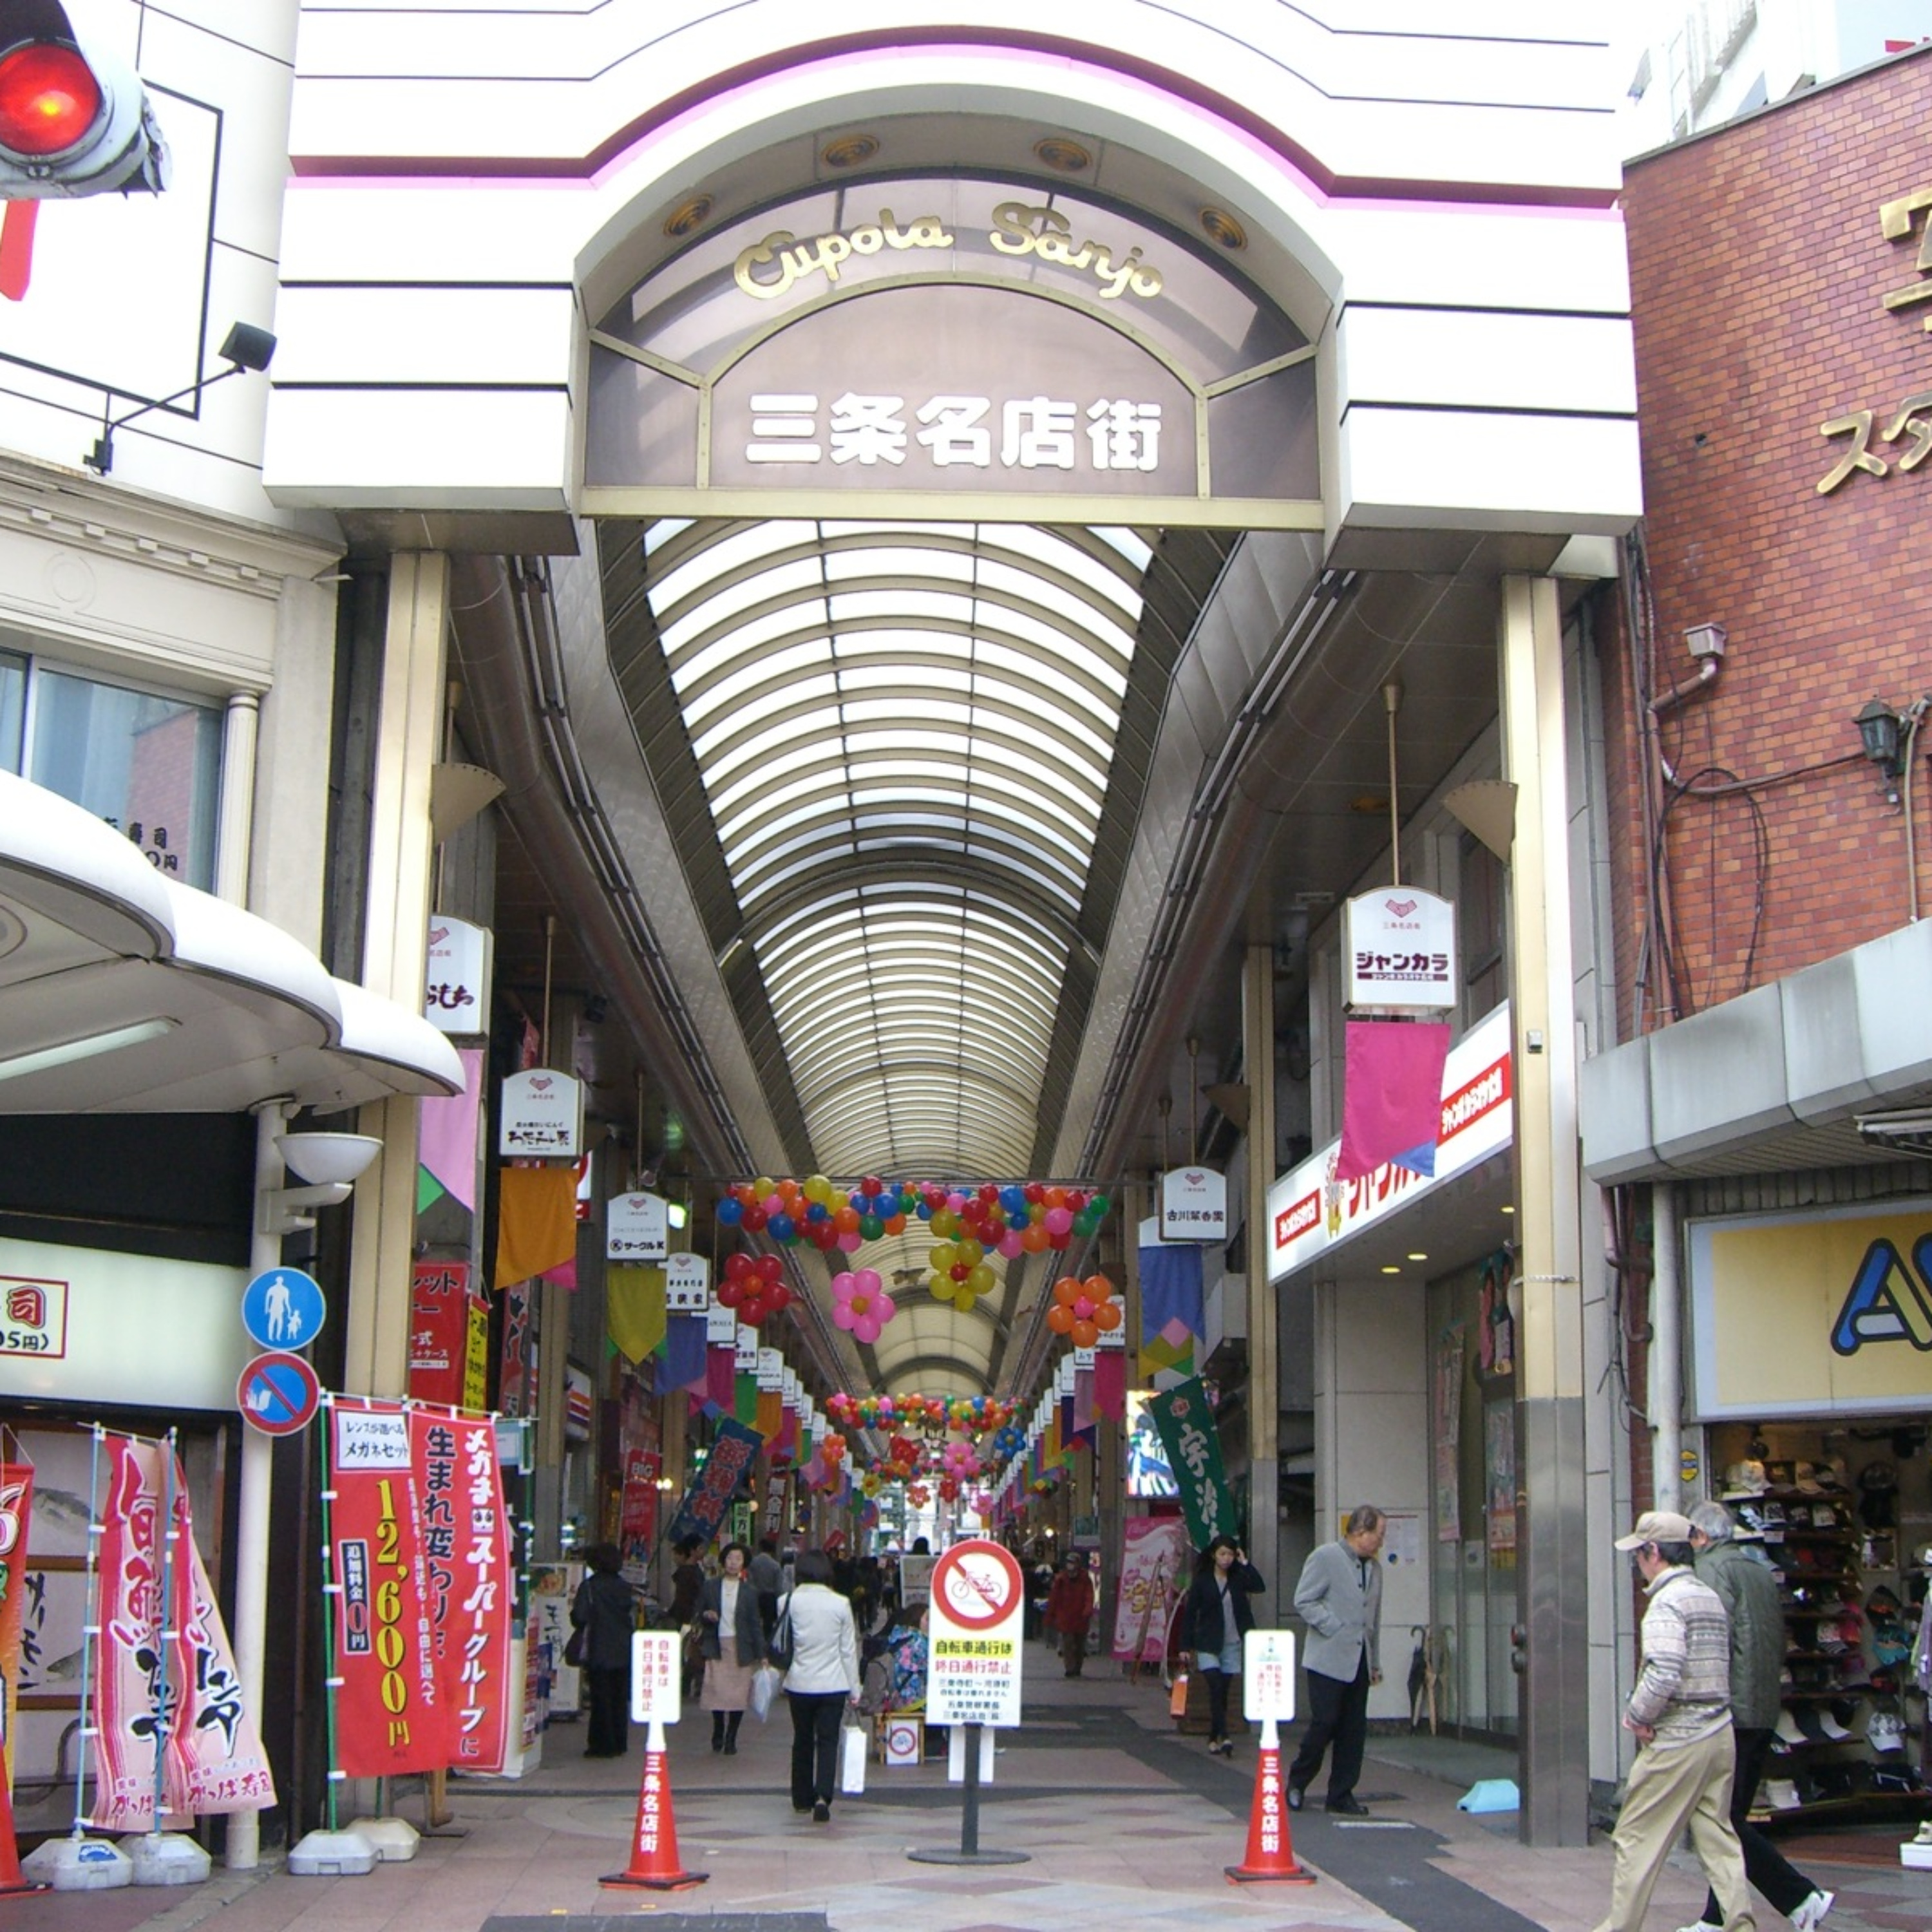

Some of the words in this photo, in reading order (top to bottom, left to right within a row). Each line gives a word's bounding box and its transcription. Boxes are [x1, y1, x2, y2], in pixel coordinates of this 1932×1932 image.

[733, 207, 953, 299] Cupola
[989, 201, 1164, 299] Sanjo
[746, 392, 1163, 473] 三条名店街
[1356, 951, 1448, 971] ジャンカラ
[424, 1426, 456, 1659] 生まれ変わり
[17, 1571, 46, 1690] サーモン
[658, 1639, 670, 1687] 自転車は
[935, 1660, 1012, 1674] 終日通行禁止
[936, 1640, 1012, 1654] 自転車通行は
[640, 1755, 662, 1853] 三条名店街
[1261, 1756, 1280, 1853] 三条名店街
